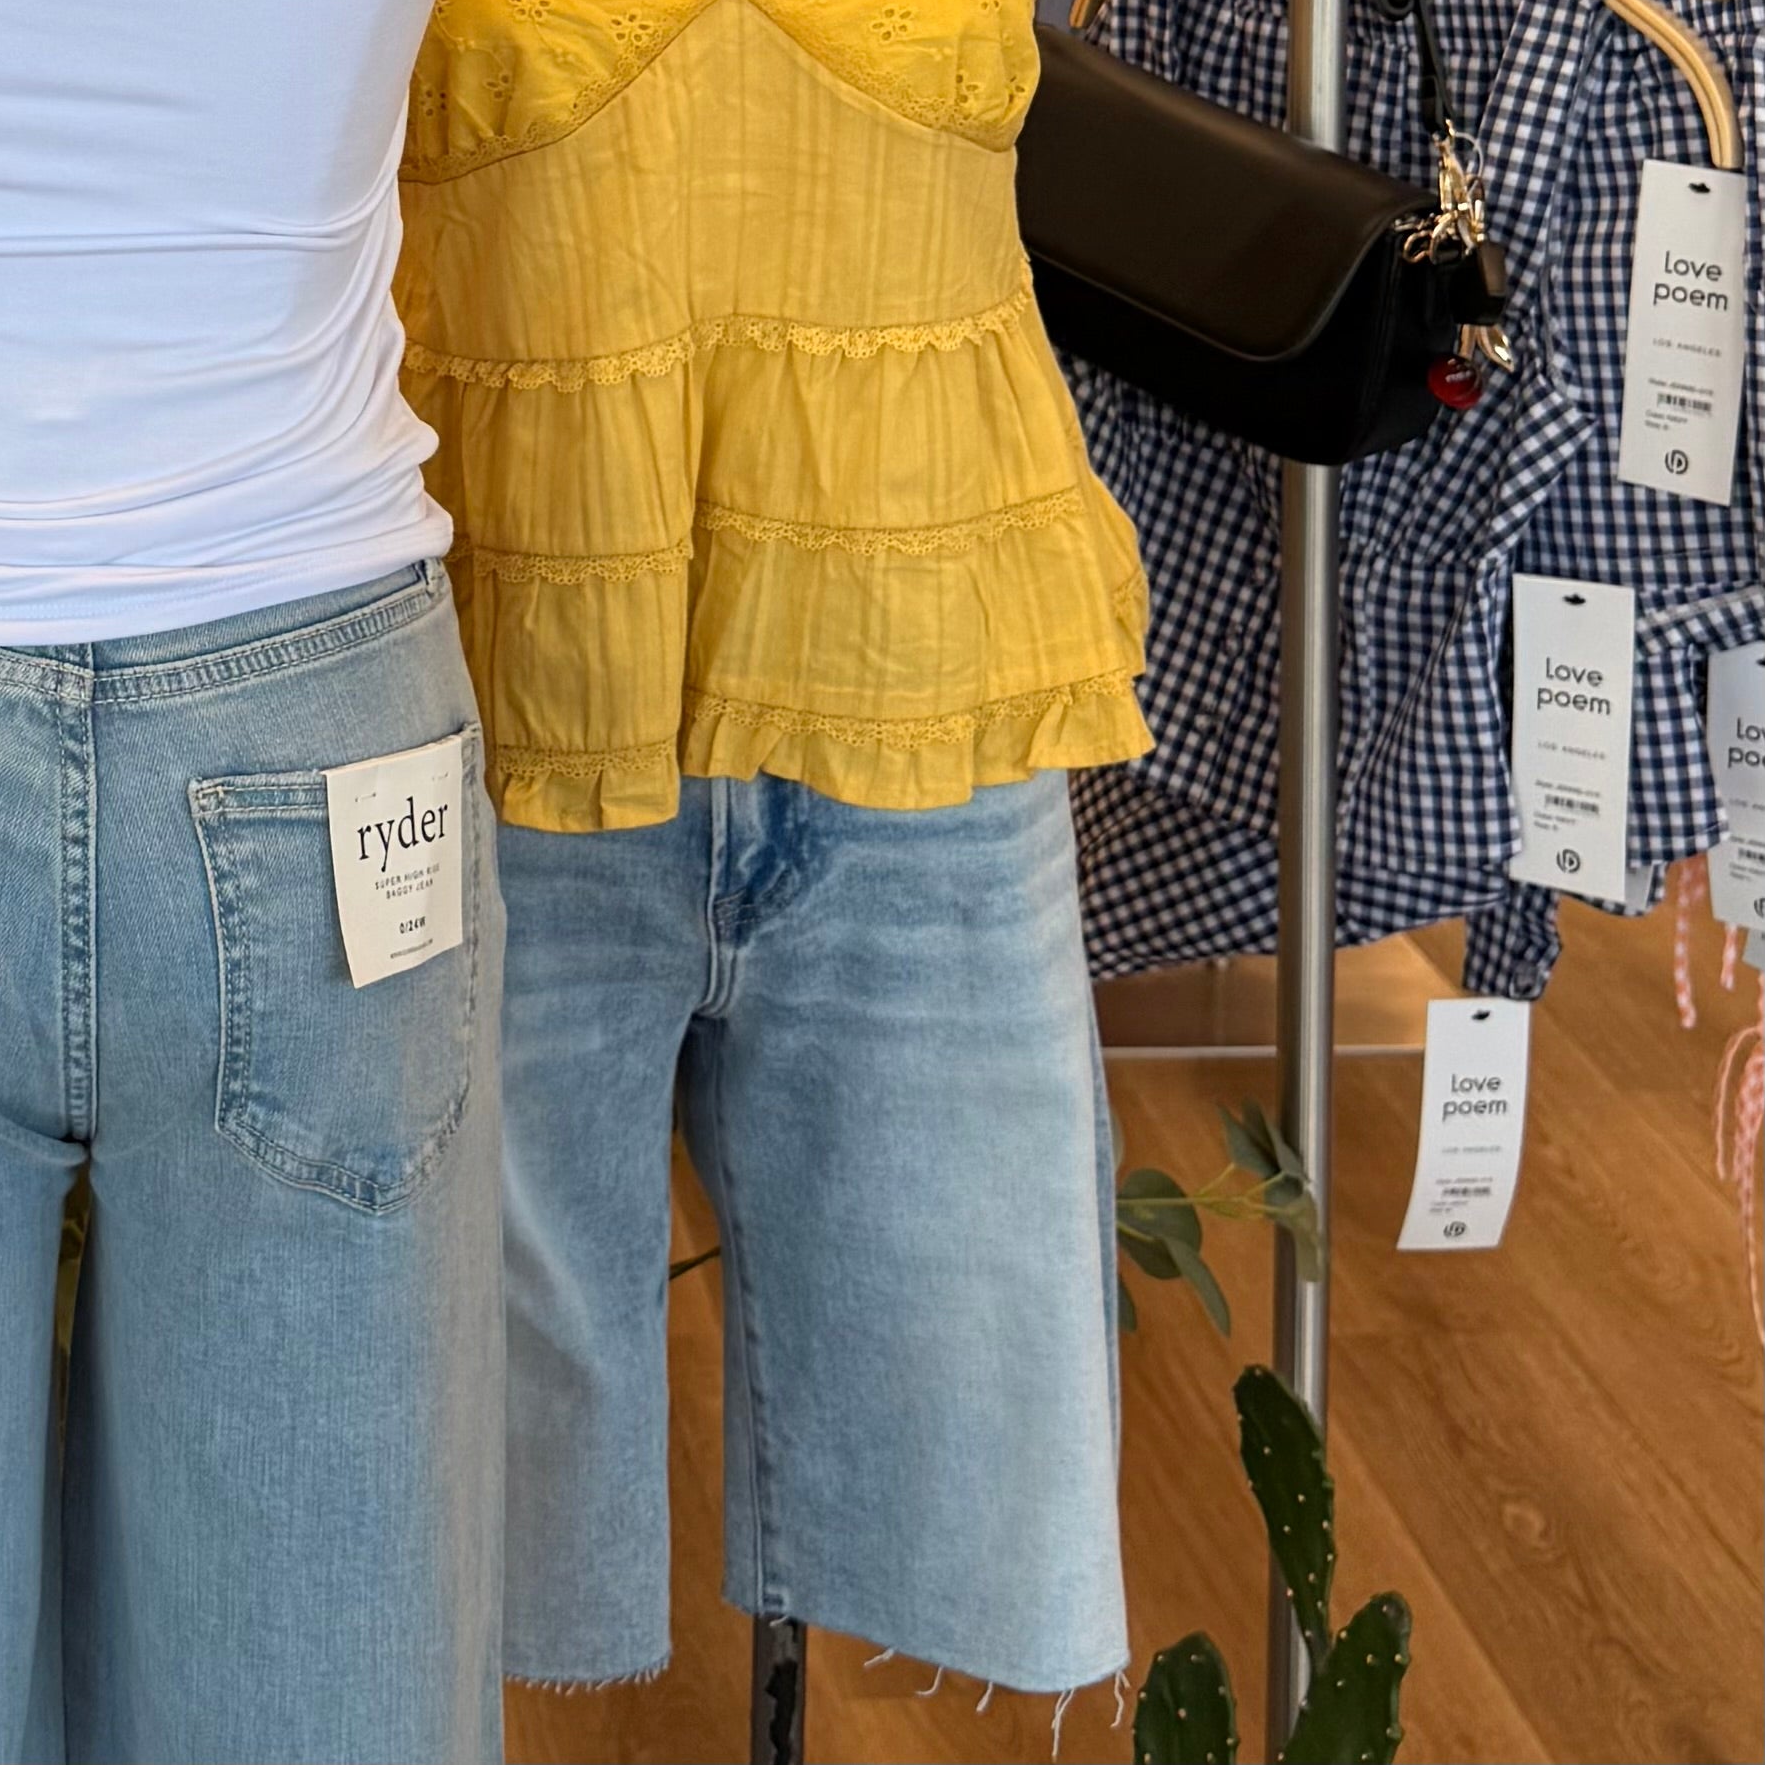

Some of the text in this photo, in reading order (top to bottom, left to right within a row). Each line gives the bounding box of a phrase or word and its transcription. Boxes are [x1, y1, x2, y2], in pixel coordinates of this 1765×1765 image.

[1653, 282, 1729, 311] poem
[1537, 687, 1610, 715] poem
[1736, 716, 1765, 741] Lo
[1727, 746, 1765, 769] po
[356, 796, 449, 872] ryder
[1442, 1099, 1507, 1123] poem
